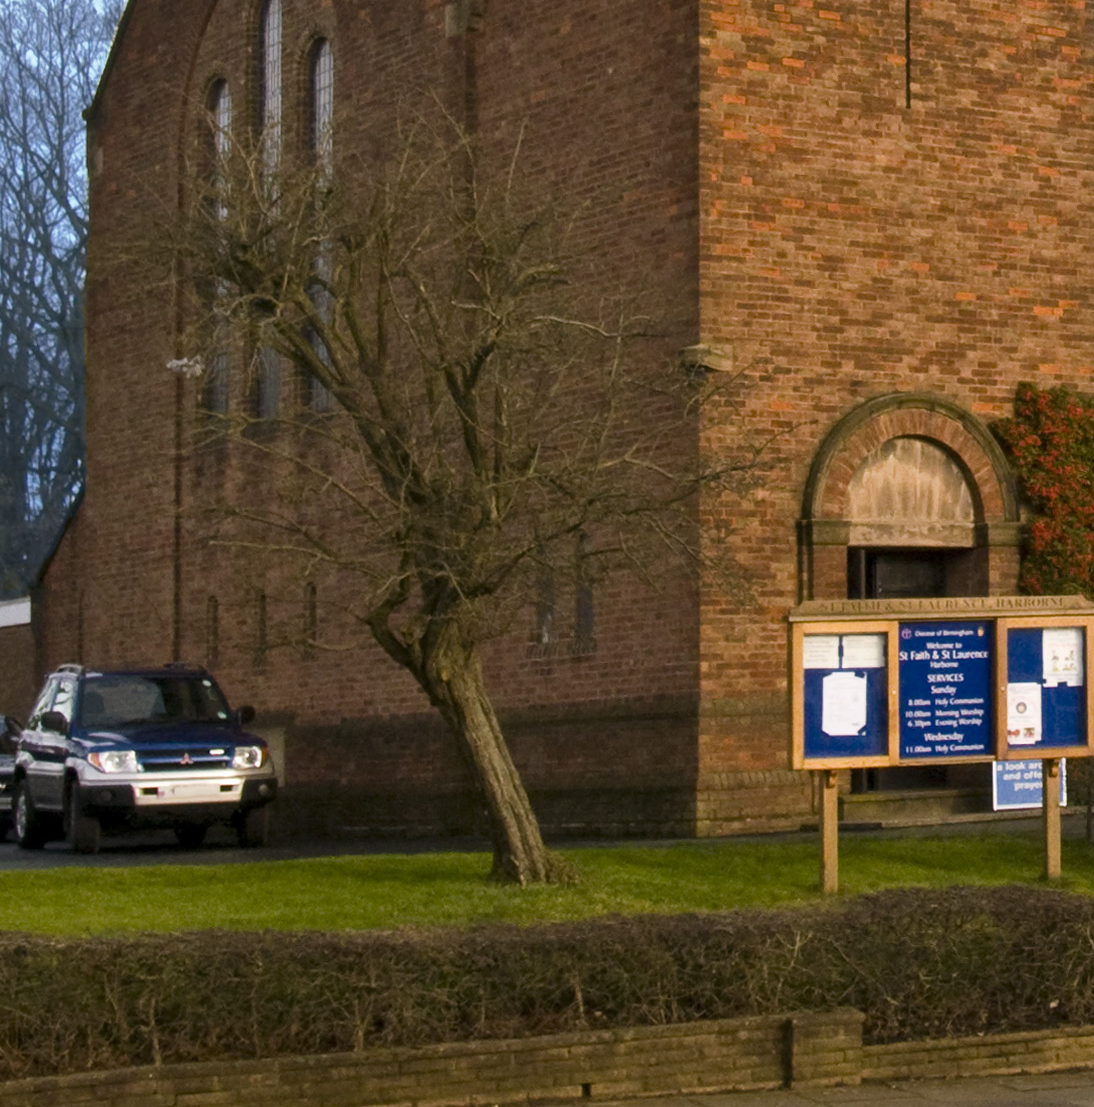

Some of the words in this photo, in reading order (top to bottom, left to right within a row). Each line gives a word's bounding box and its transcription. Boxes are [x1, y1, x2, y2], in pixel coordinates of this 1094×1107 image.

[884, 602, 893, 611] &
[996, 597, 1065, 608] HARBORNE
[899, 650, 908, 661] St
[910, 650, 930, 661] Faith
[932, 650, 939, 660] &
[941, 650, 950, 660] St
[953, 650, 988, 659] Laurence
[930, 661, 959, 669] Harborne
[927, 673, 964, 683] SERVICES
[930, 685, 957, 696] Sunday
[935, 698, 948, 707] Holy
[935, 710, 959, 718] Morning
[960, 708, 984, 717] Worship
[935, 719, 958, 728] Evening
[958, 718, 983, 726] Worship
[924, 732, 964, 743] Wednesday
[935, 744, 948, 754] Holy
[1006, 762, 1026, 770] look
[1003, 772, 1021, 781] and
[1024, 771, 1043, 780] offe
